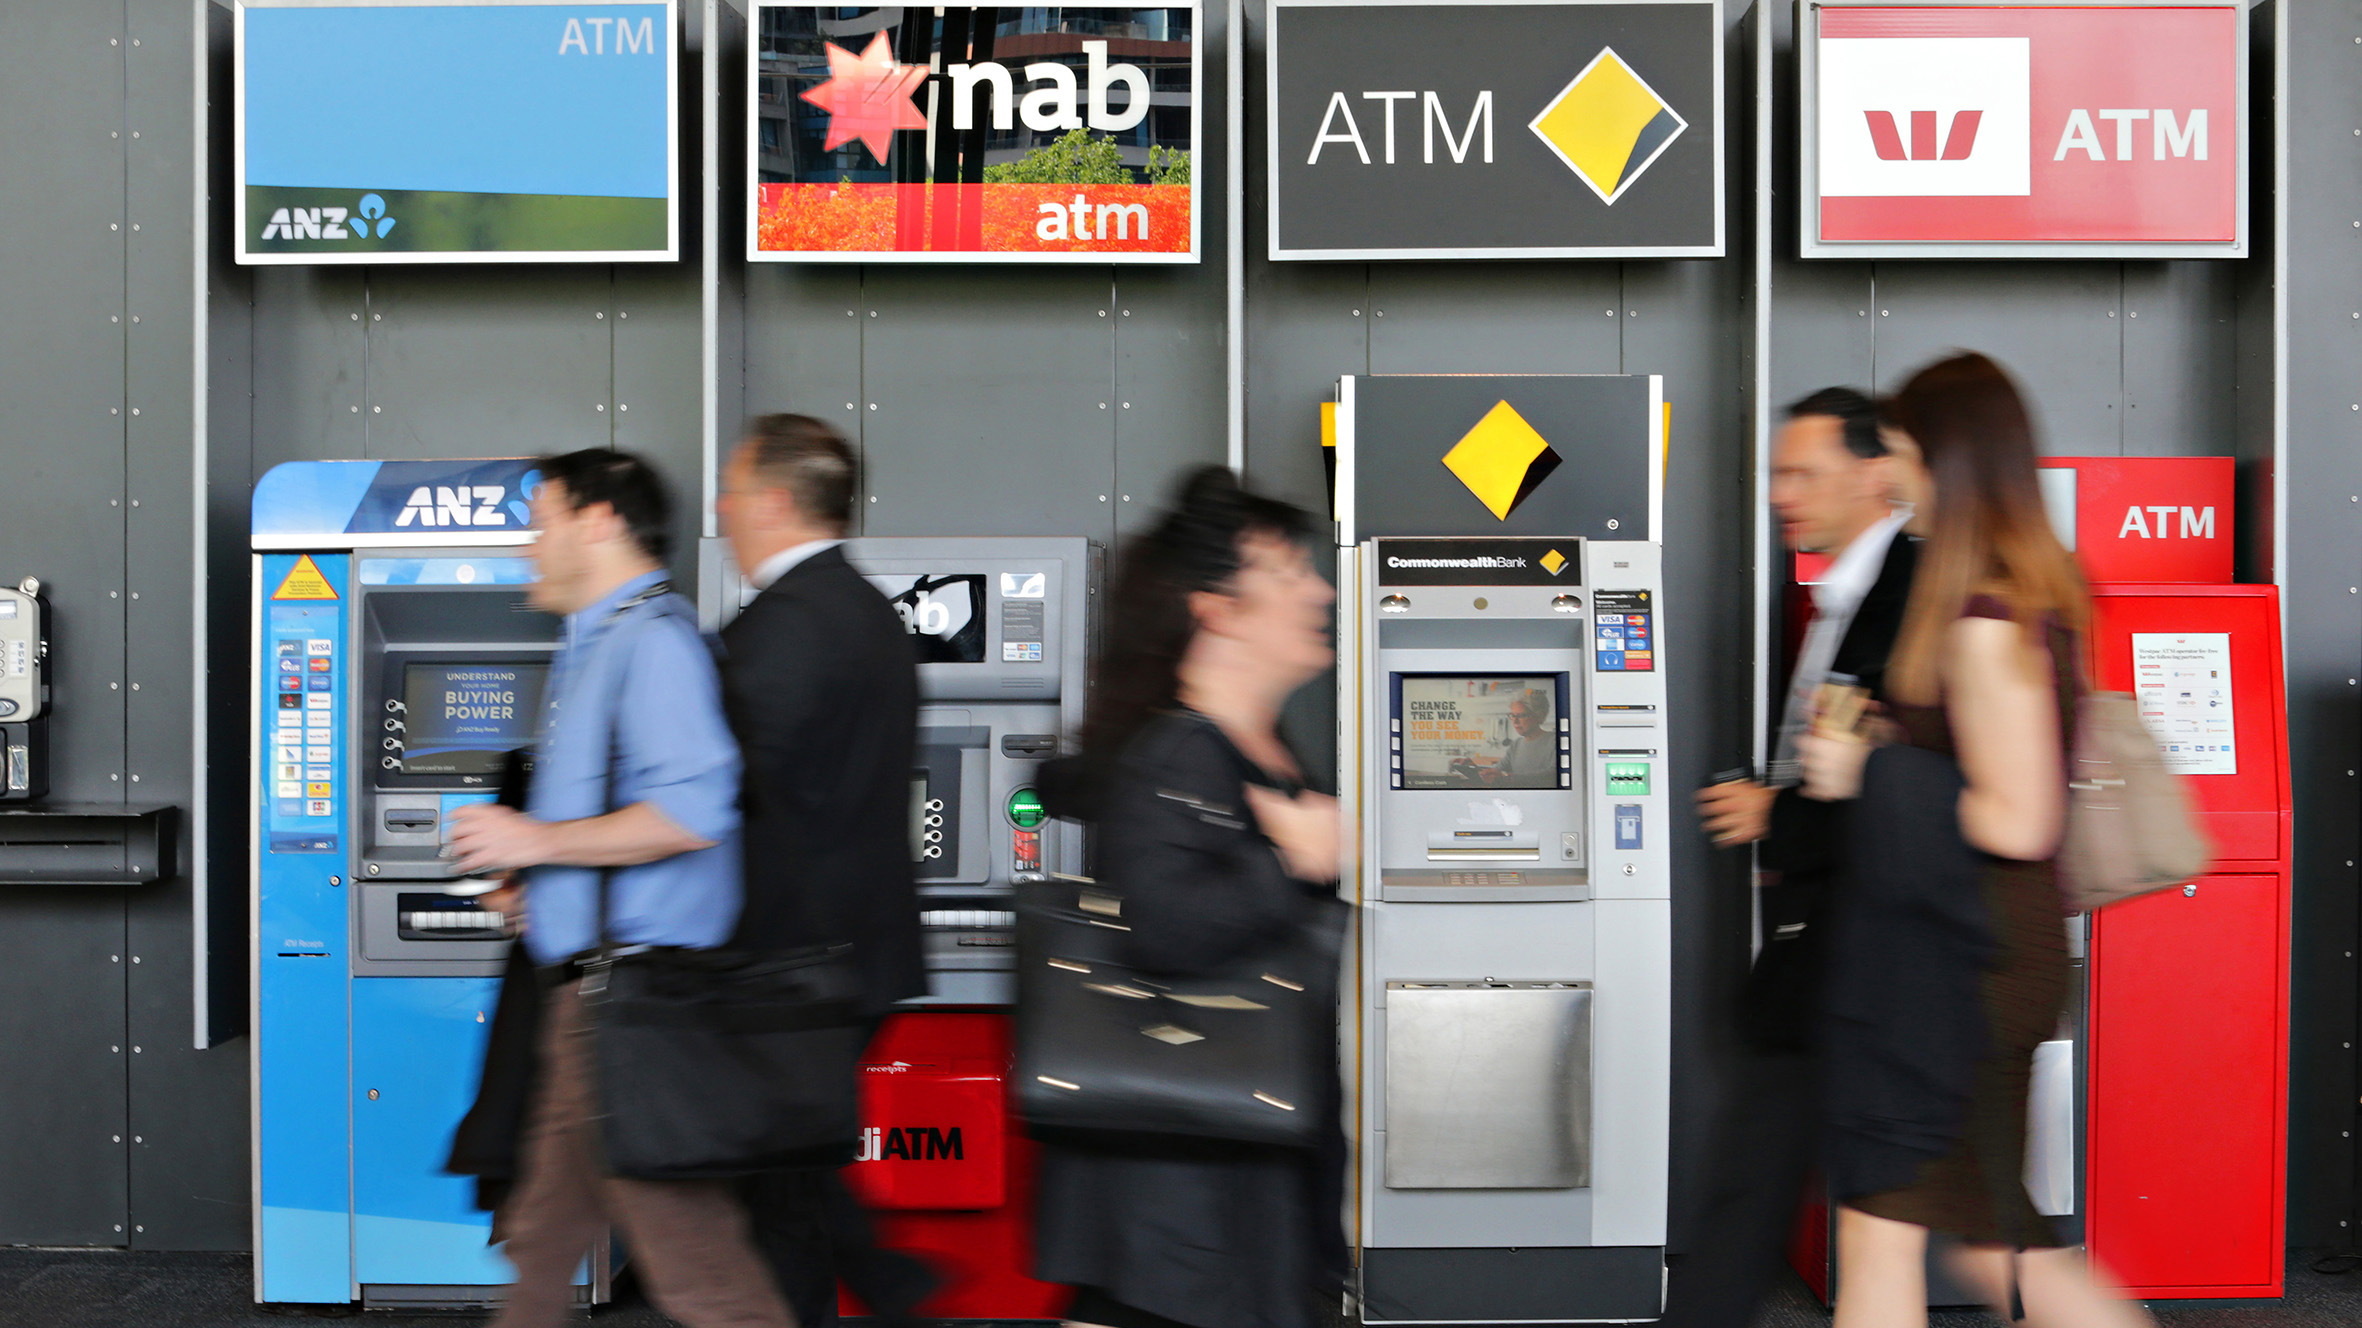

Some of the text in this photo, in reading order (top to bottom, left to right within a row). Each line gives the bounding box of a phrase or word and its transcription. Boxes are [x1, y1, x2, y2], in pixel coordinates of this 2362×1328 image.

[559, 18, 654, 55] ATM
[948, 41, 1150, 132] nab
[1307, 91, 1494, 164] ATM
[2054, 109, 2209, 161] ATM
[261, 207, 348, 240] ANZ
[1032, 194, 1149, 242] atm
[395, 486, 505, 527] ANZ
[2119, 506, 2215, 539] ATM
[1387, 556, 1527, 569] CommonwealthBank
[892, 590, 950, 635] ab
[310, 643, 330, 652] VISA
[446, 672, 516, 681] UNDERSTAND
[445, 691, 515, 704] BUYING
[1411, 701, 1456, 710] CHANGE
[445, 706, 514, 719] POWER
[1411, 711, 1462, 720] THE WAY
[1411, 721, 1459, 730] YOU SEE
[1411, 731, 1486, 740] YOUR MONEY.
[866, 1066, 907, 1074] receipts
[853, 1127, 964, 1161] diATM
